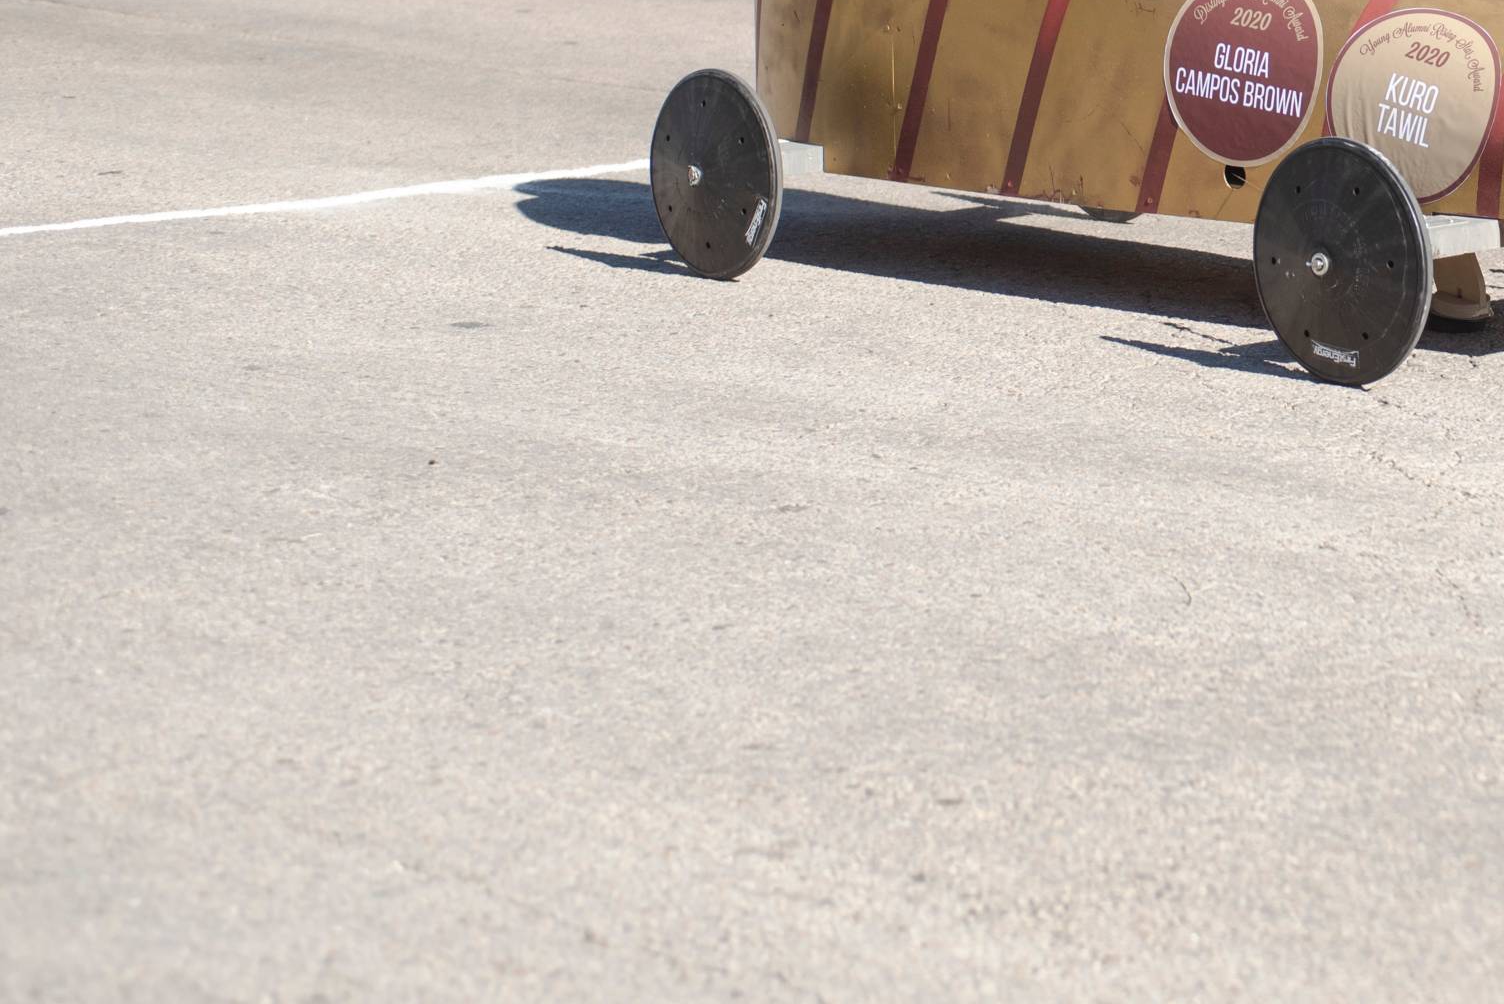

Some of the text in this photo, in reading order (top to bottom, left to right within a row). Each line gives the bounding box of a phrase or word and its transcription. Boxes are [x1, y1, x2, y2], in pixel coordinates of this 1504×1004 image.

[1230, 6, 1272, 31] 2020
[1282, 5, 1309, 41] Award
[1214, 42, 1270, 78] GLORIA
[1359, 22, 1485, 92] Young Alumni Rising Star Award
[1404, 41, 1451, 68] 2020
[1175, 67, 1303, 118] CAMPOS BROWN
[1384, 72, 1439, 114] KURO
[1377, 103, 1429, 148] TAWIL
